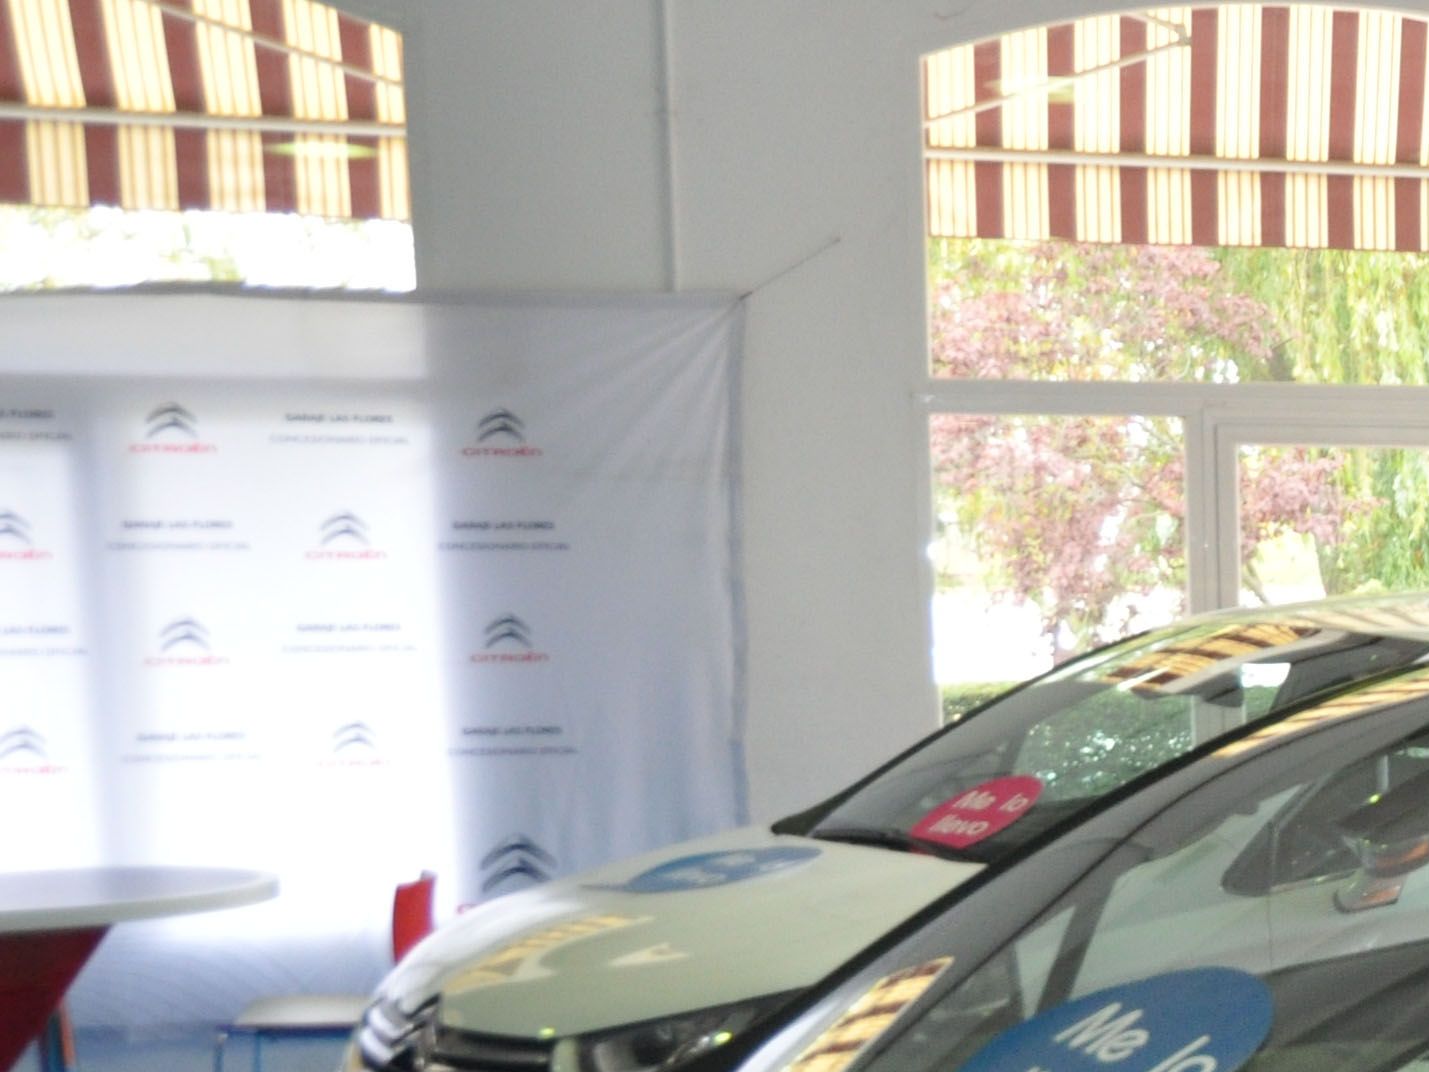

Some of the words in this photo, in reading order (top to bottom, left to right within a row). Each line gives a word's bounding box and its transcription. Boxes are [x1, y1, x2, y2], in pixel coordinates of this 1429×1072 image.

[952, 790, 998, 812] Me
[997, 793, 1029, 813] lo
[1052, 1002, 1151, 1063] Me
